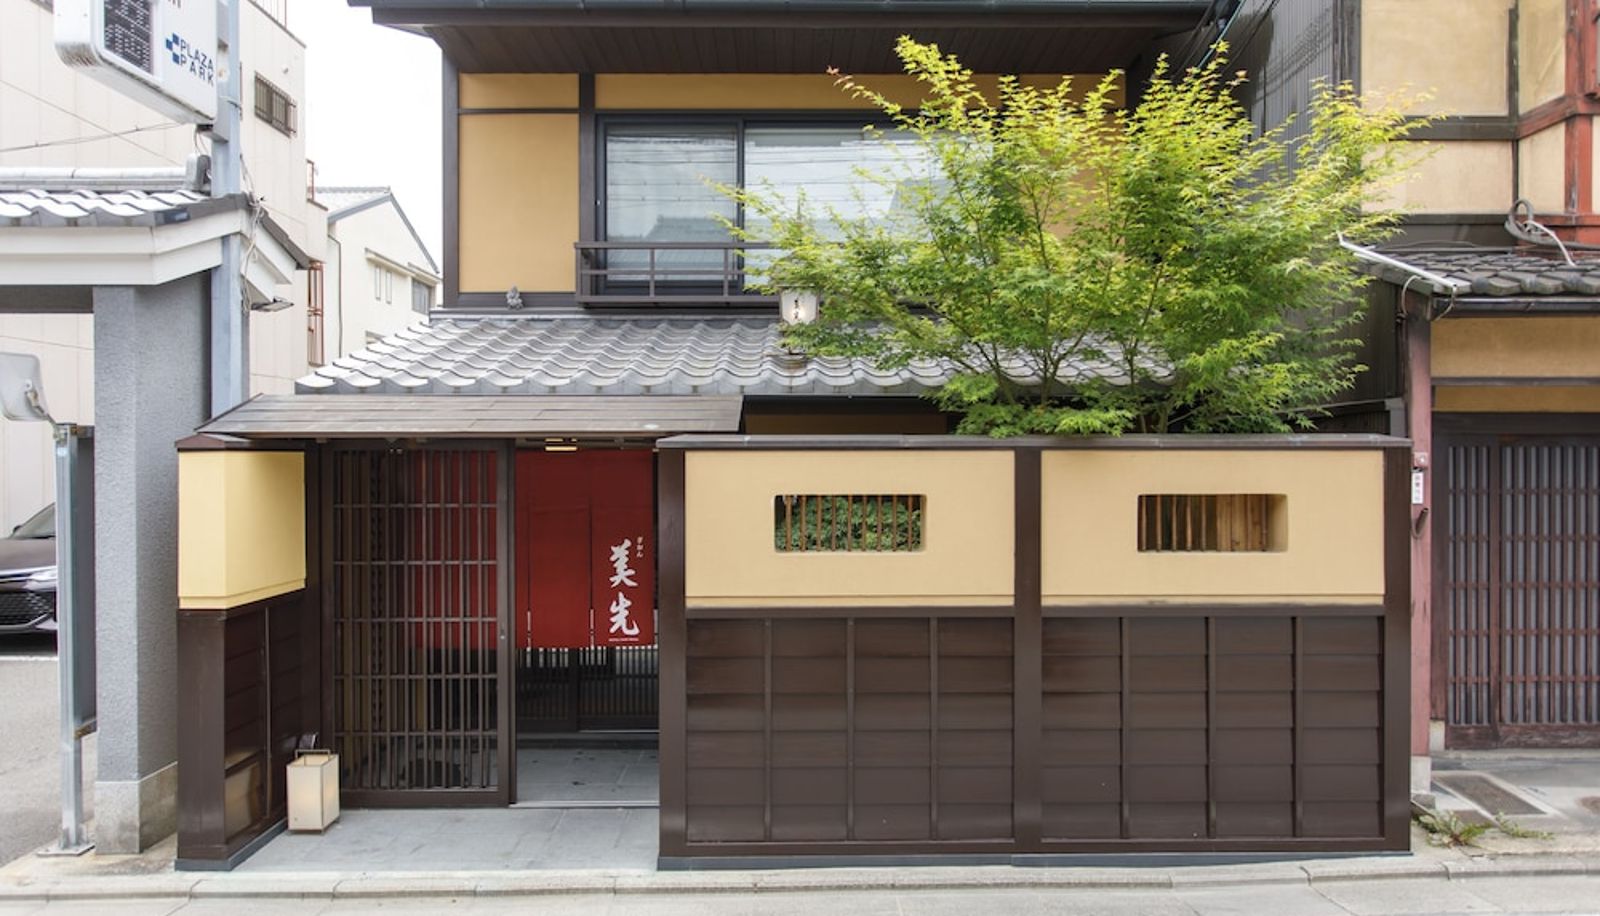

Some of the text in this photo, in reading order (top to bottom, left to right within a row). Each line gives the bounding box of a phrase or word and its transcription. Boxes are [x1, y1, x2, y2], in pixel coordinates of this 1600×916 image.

[181, 38, 214, 72] PLAZA
[181, 54, 214, 87] PARK
[609, 538, 640, 636] 美先
